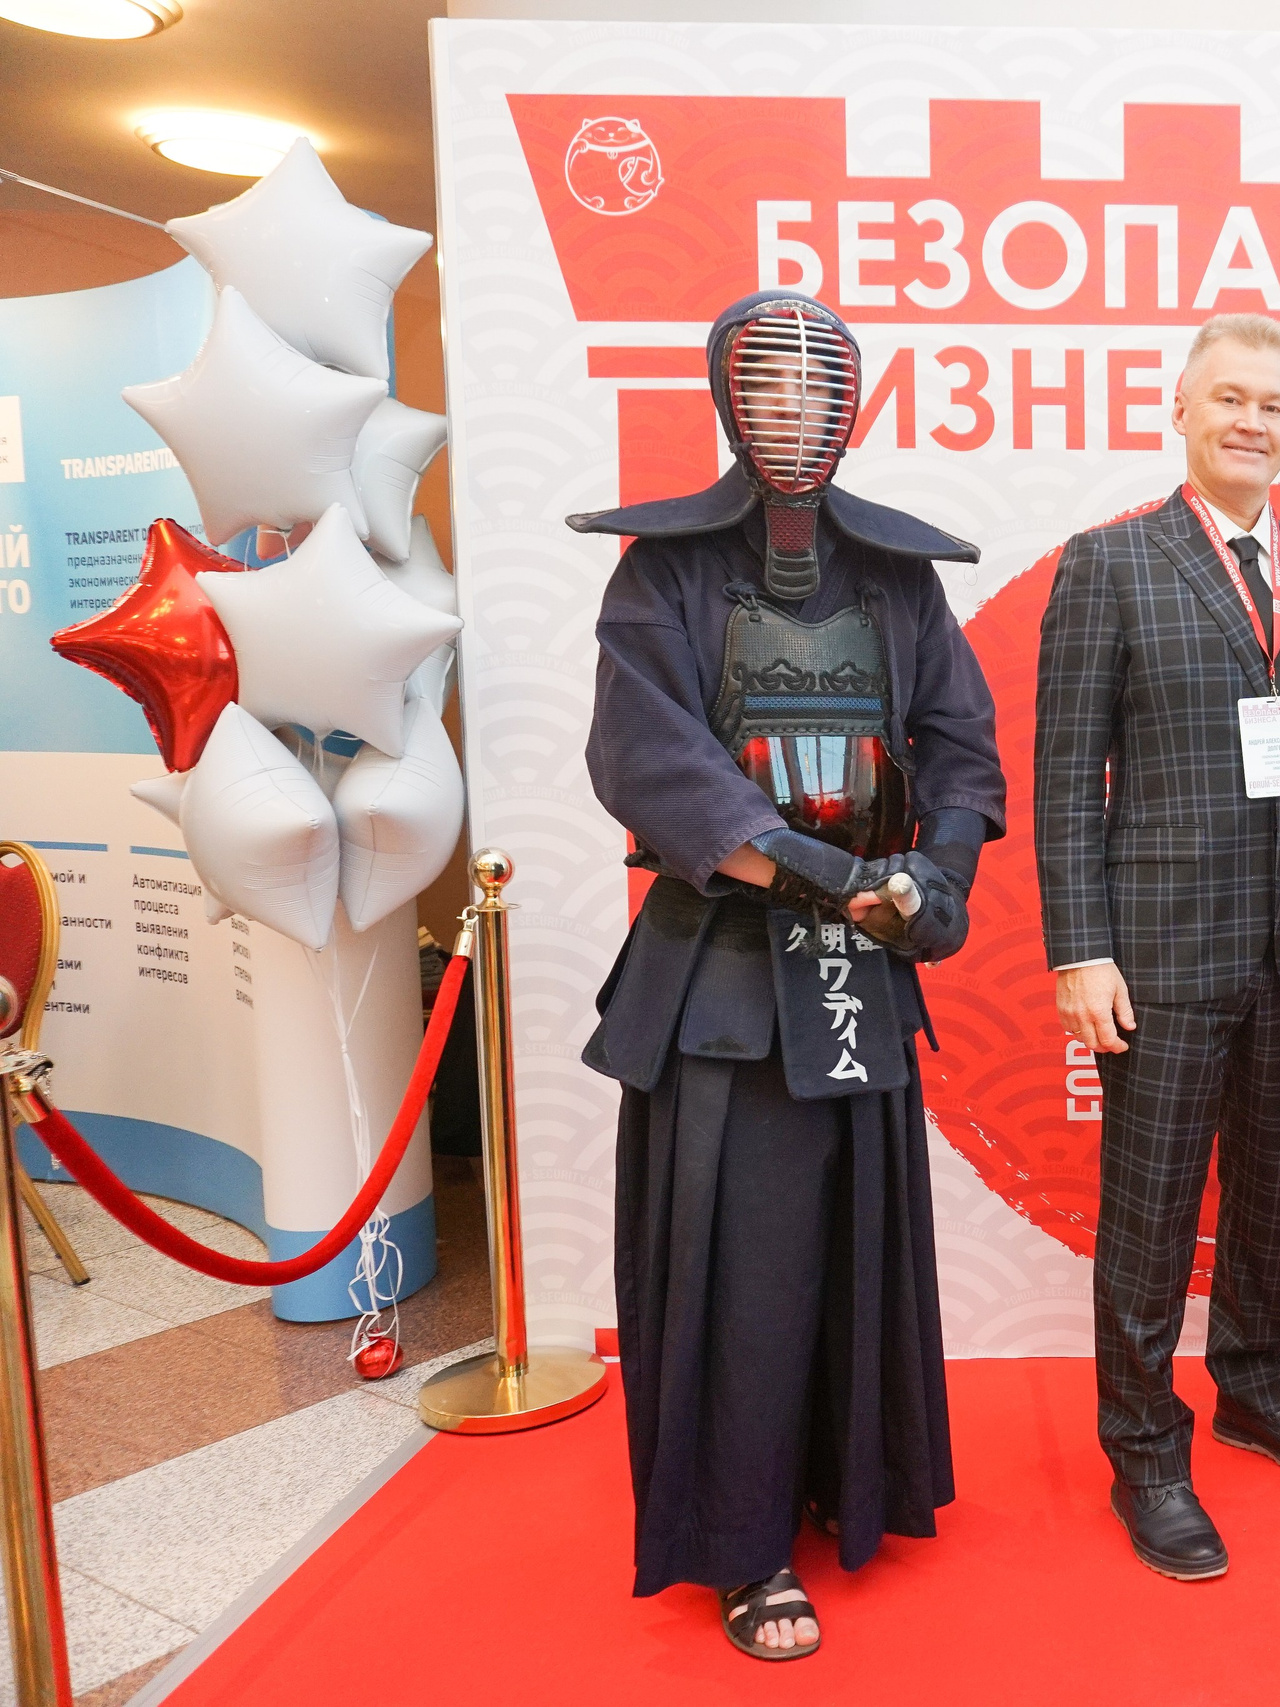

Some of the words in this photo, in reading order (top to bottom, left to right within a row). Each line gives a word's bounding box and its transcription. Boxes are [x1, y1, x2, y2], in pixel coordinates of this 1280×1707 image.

[1190, 495, 1213, 528] БИЗНЕСА
[65, 528, 140, 545] TRANSPARENT
[1209, 526, 1241, 585] БЕЗОПАСНОСТЬ
[1236, 583, 1253, 612] ФОРУМ
[1244, 716, 1277, 725] БИЗНЕСА
[132, 873, 202, 897] Автоматизация
[134, 900, 179, 916] процесса
[59, 916, 112, 930] анности
[135, 922, 189, 939] выявления
[136, 943, 189, 962] конфликта
[138, 966, 188, 984] интересов
